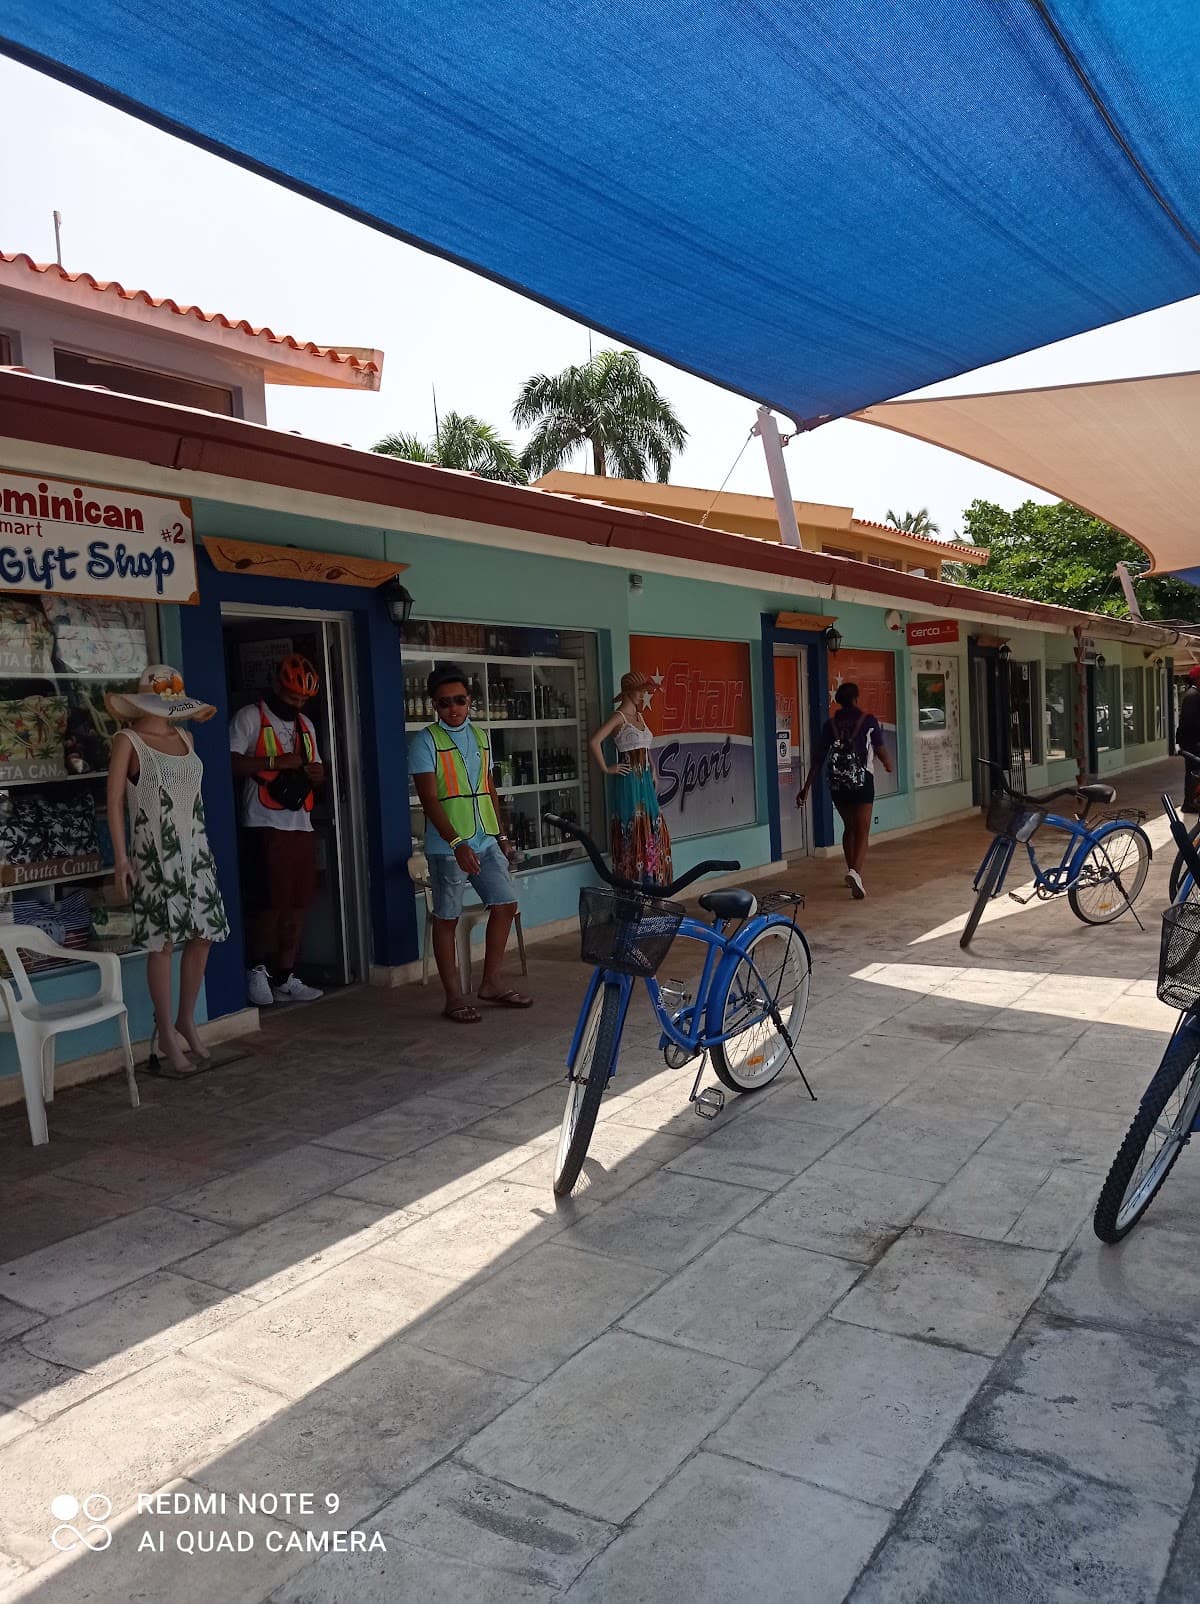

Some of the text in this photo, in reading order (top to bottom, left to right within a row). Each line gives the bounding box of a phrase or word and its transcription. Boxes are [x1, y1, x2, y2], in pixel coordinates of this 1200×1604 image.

[160, 522, 186, 545] #2
[0, 541, 175, 594] Gift Shop
[911, 627, 940, 638] cerca
[661, 661, 744, 732] Star
[656, 736, 732, 812] Sport
[15, 858, 99, 884] Punta Cana
